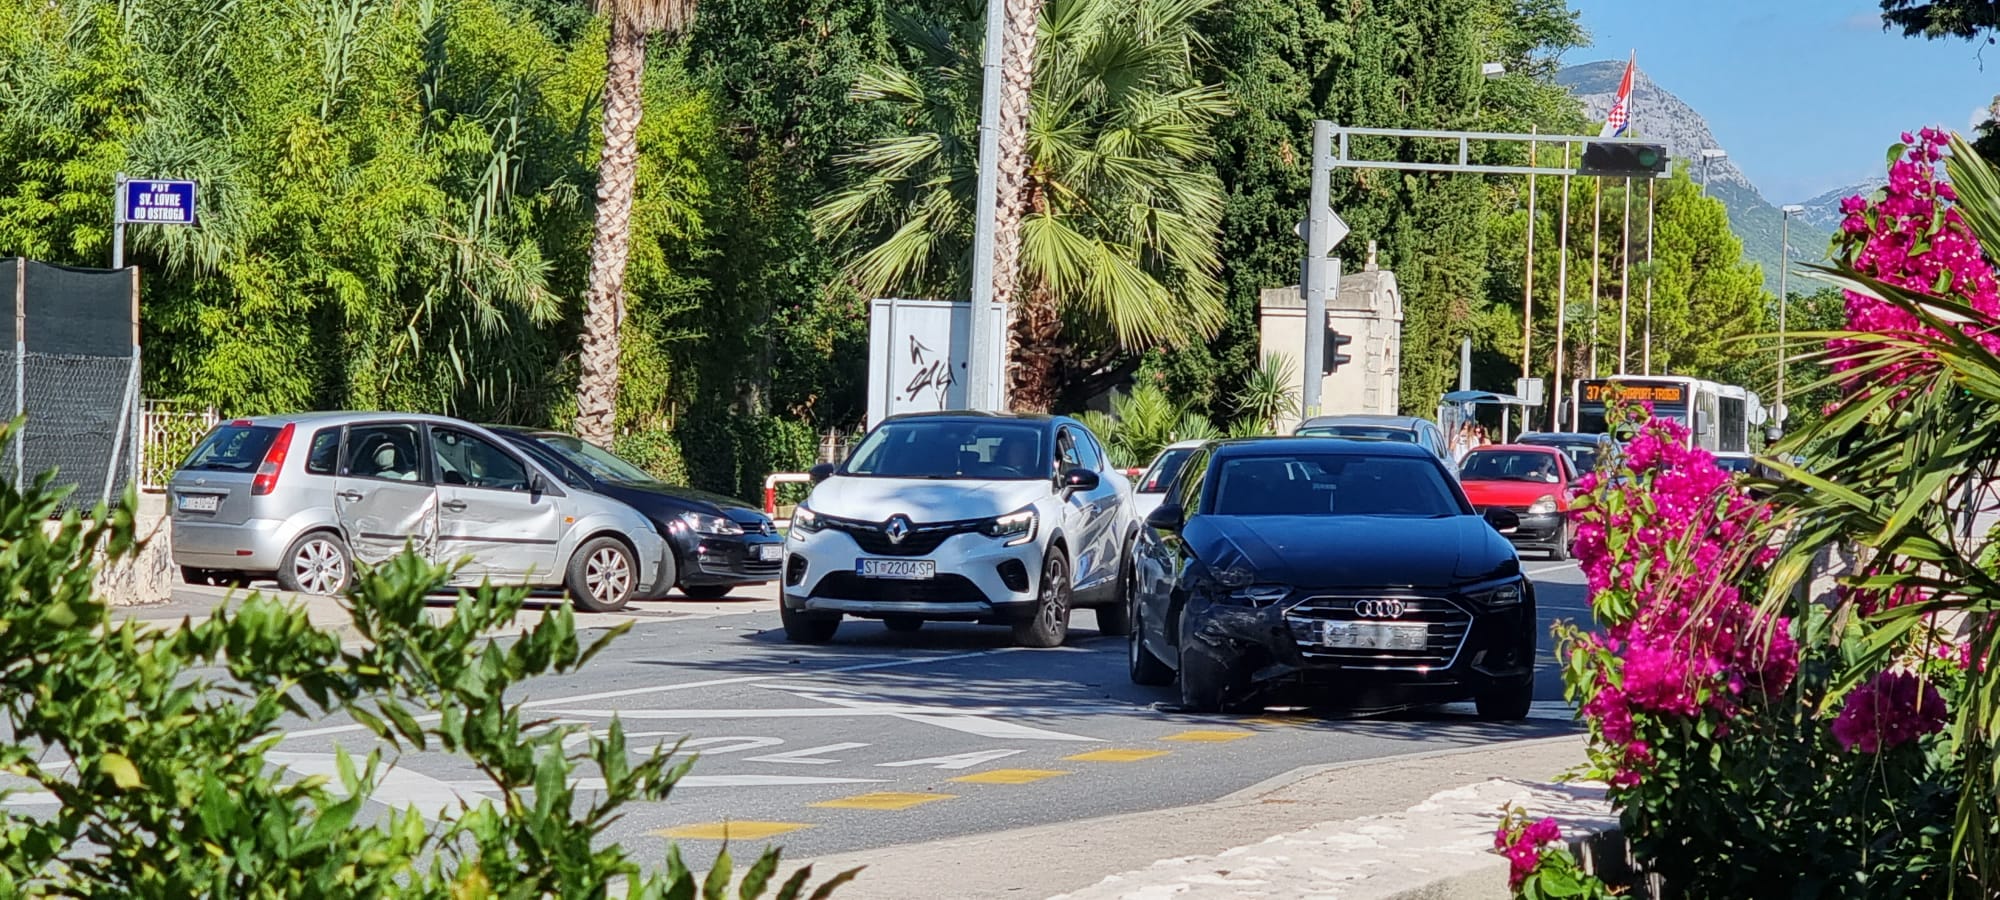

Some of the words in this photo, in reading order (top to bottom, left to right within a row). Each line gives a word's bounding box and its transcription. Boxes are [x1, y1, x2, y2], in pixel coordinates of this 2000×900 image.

[151, 183, 170, 192] PUT
[139, 193, 153, 206] SV.
[154, 193, 181, 207] LOVRE
[134, 207, 146, 219] OD
[147, 207, 184, 220] OSTROGA
[1586, 385, 1600, 401] 37
[865, 560, 880, 574] ST
